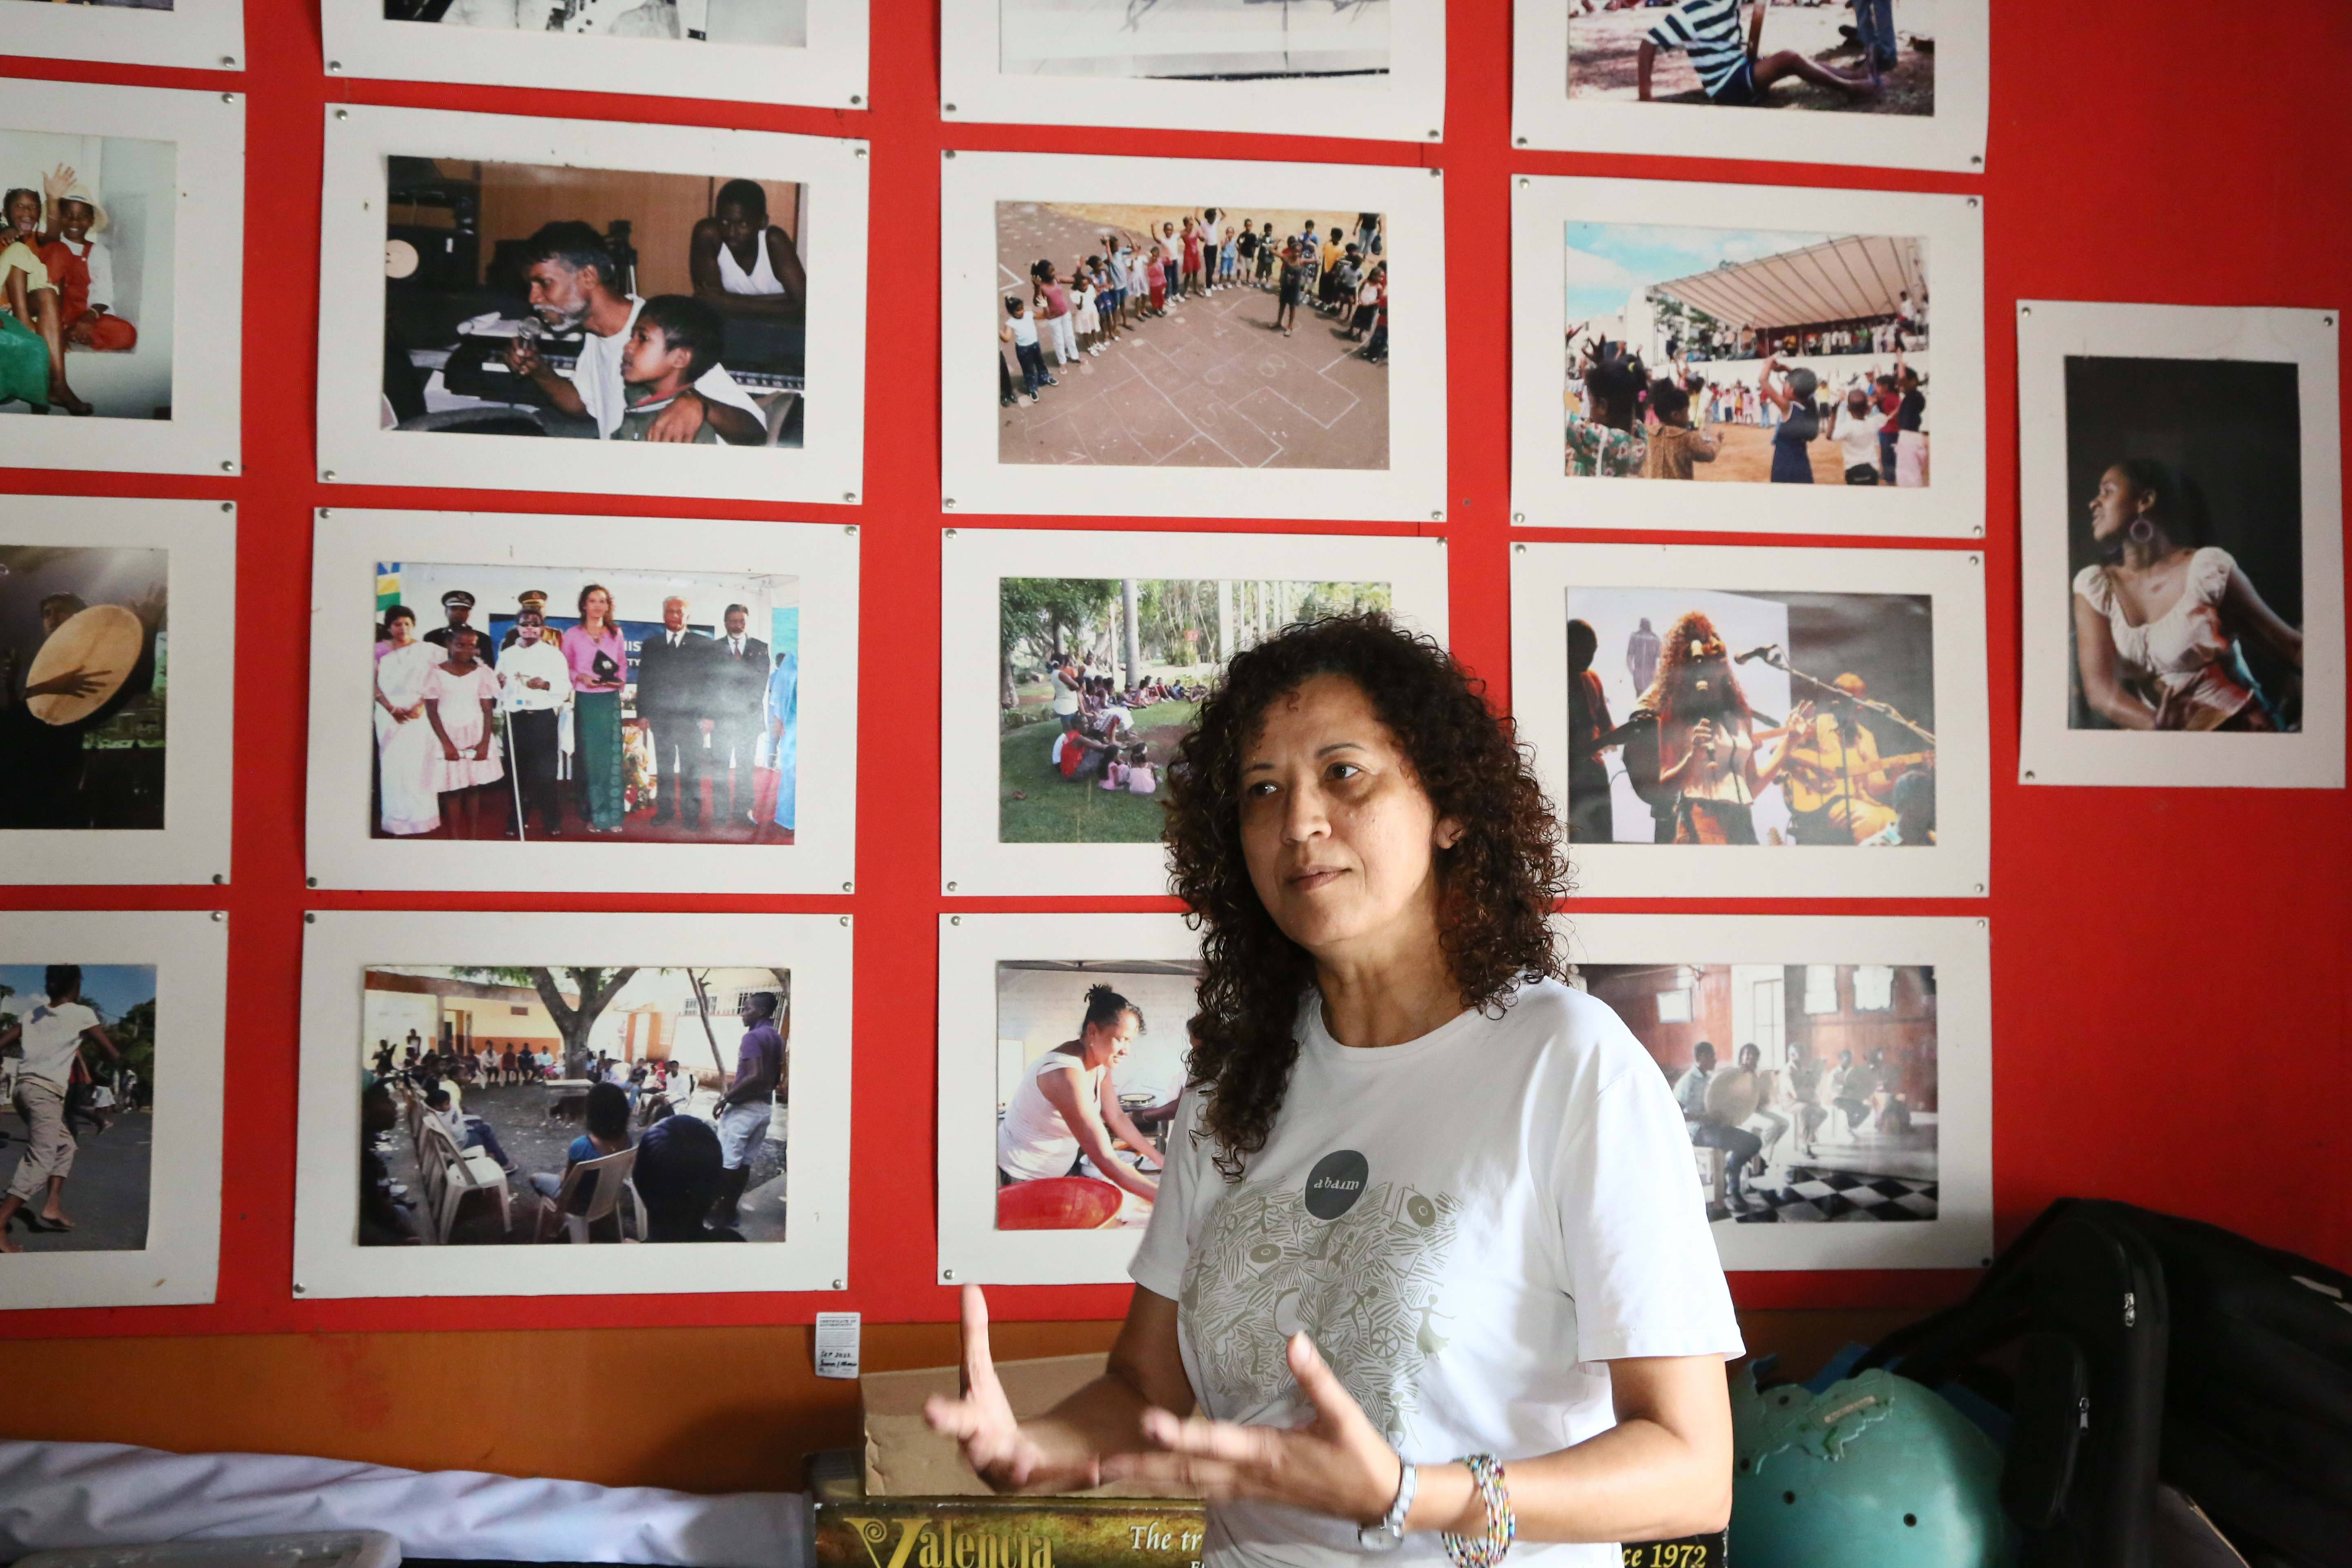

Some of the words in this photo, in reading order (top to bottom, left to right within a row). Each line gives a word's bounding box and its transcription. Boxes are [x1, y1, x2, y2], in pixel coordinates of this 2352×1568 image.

[1314, 1176, 1359, 1190] abaim
[843, 1518, 1056, 1568] Valencia
[1129, 1522, 1172, 1550] The
[1650, 1544, 1707, 1568] 1972
